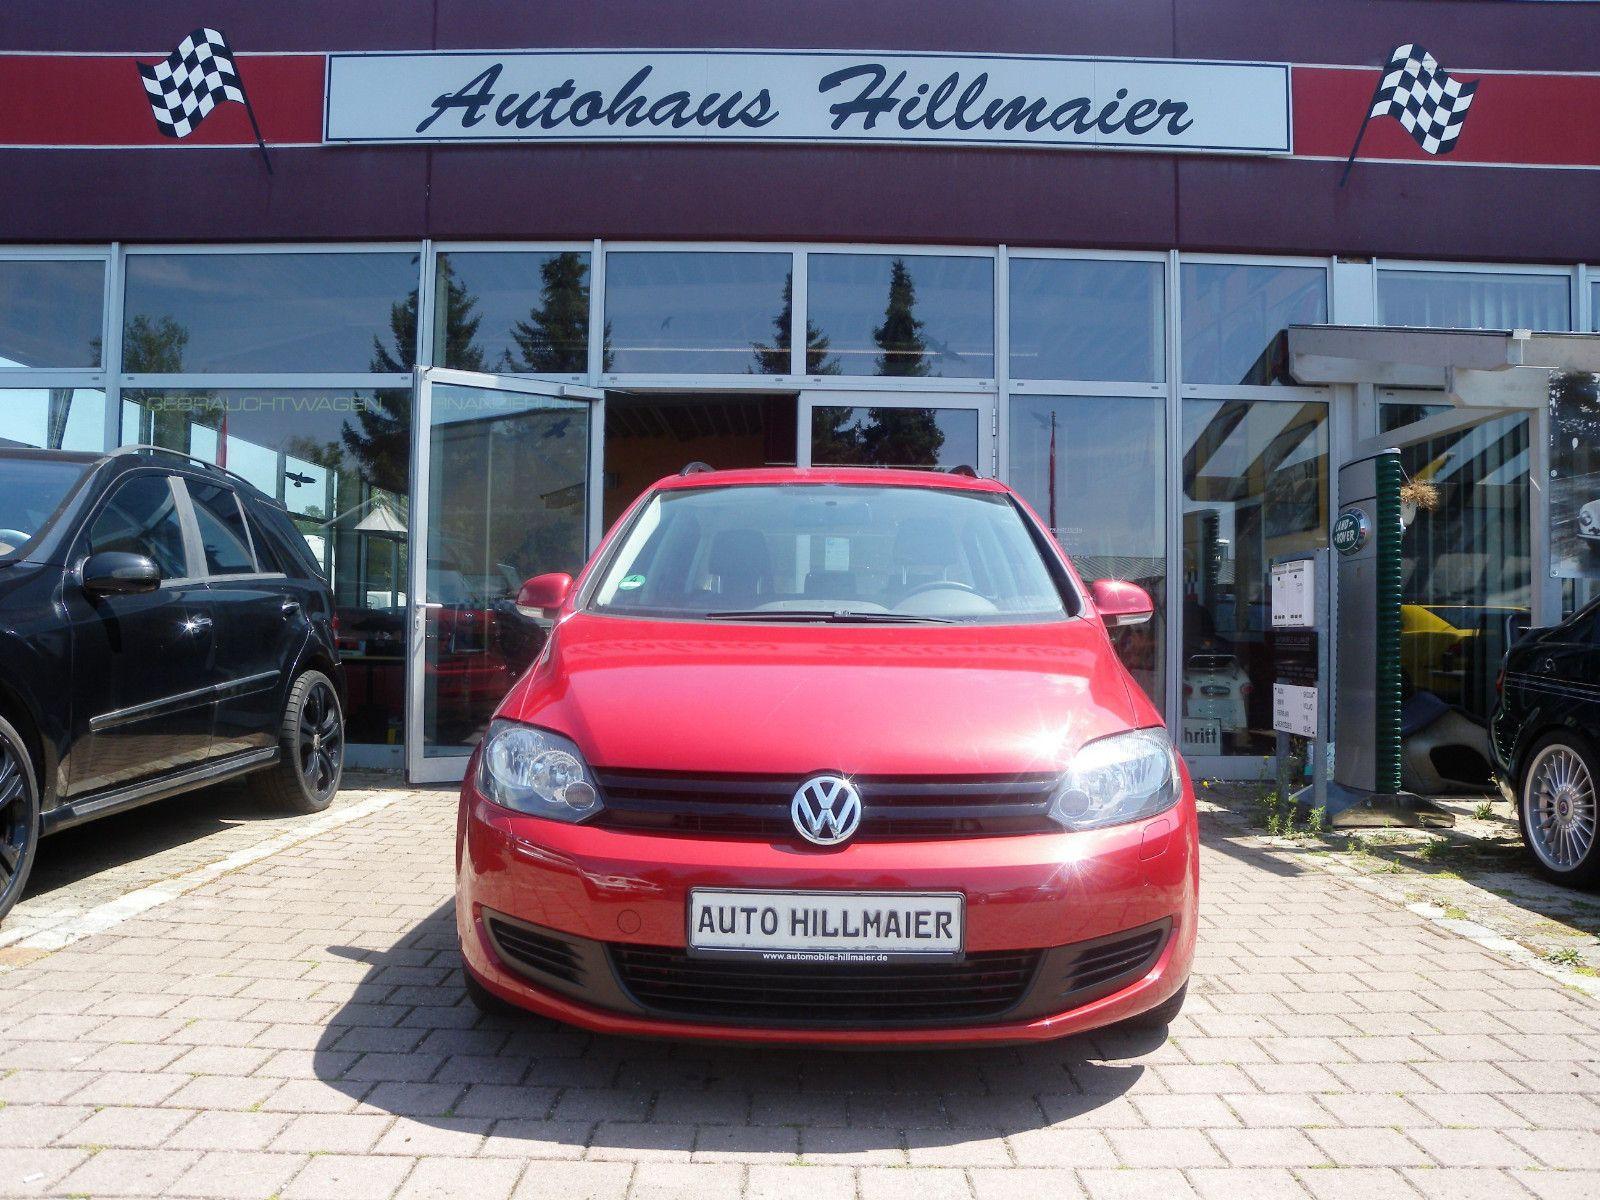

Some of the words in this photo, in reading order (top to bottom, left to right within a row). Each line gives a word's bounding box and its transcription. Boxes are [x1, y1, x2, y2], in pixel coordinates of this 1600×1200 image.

[416, 63, 779, 134] Autohaus
[818, 64, 1194, 136] Hillmaier
[146, 396, 383, 412] GEBRAUCHTWAGEN
[1335, 518, 1350, 533] LAND
[1336, 529, 1355, 544] ROVER
[698, 906, 778, 935] AUTO
[790, 908, 953, 939] HILLMAIER
[762, 952, 888, 962] www.automobile-hillmaier.de
